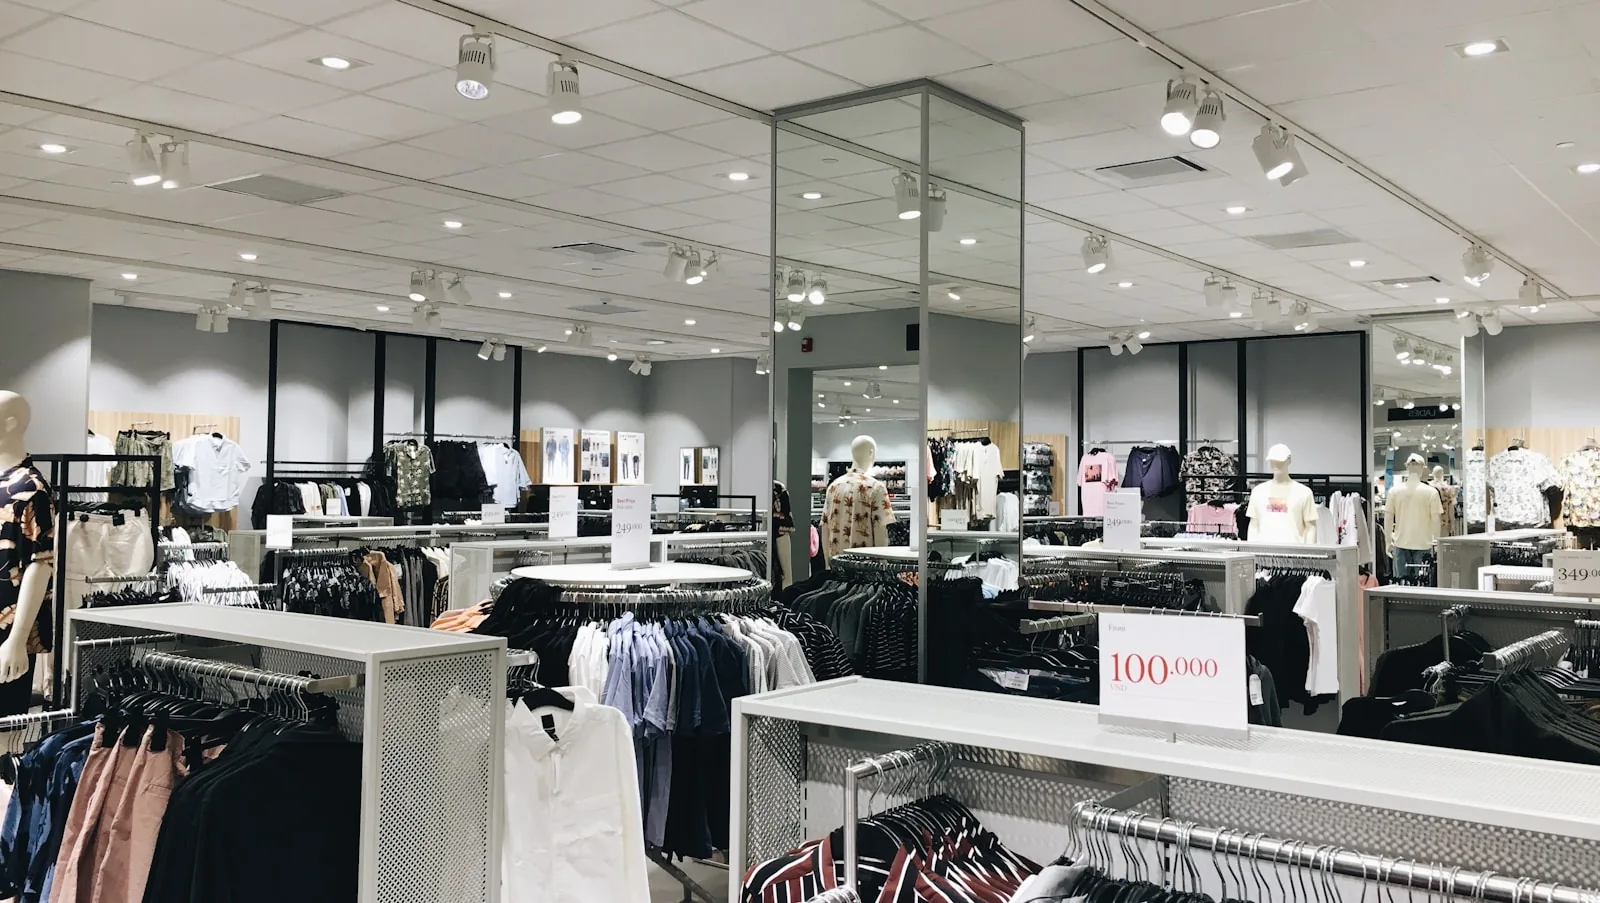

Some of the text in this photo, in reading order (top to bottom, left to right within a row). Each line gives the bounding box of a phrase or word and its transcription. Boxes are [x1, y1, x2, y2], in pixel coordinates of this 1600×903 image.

[1109, 624, 1126, 632] From
[1111, 652, 1218, 685] 100.000
[1109, 683, 1128, 692] VND
